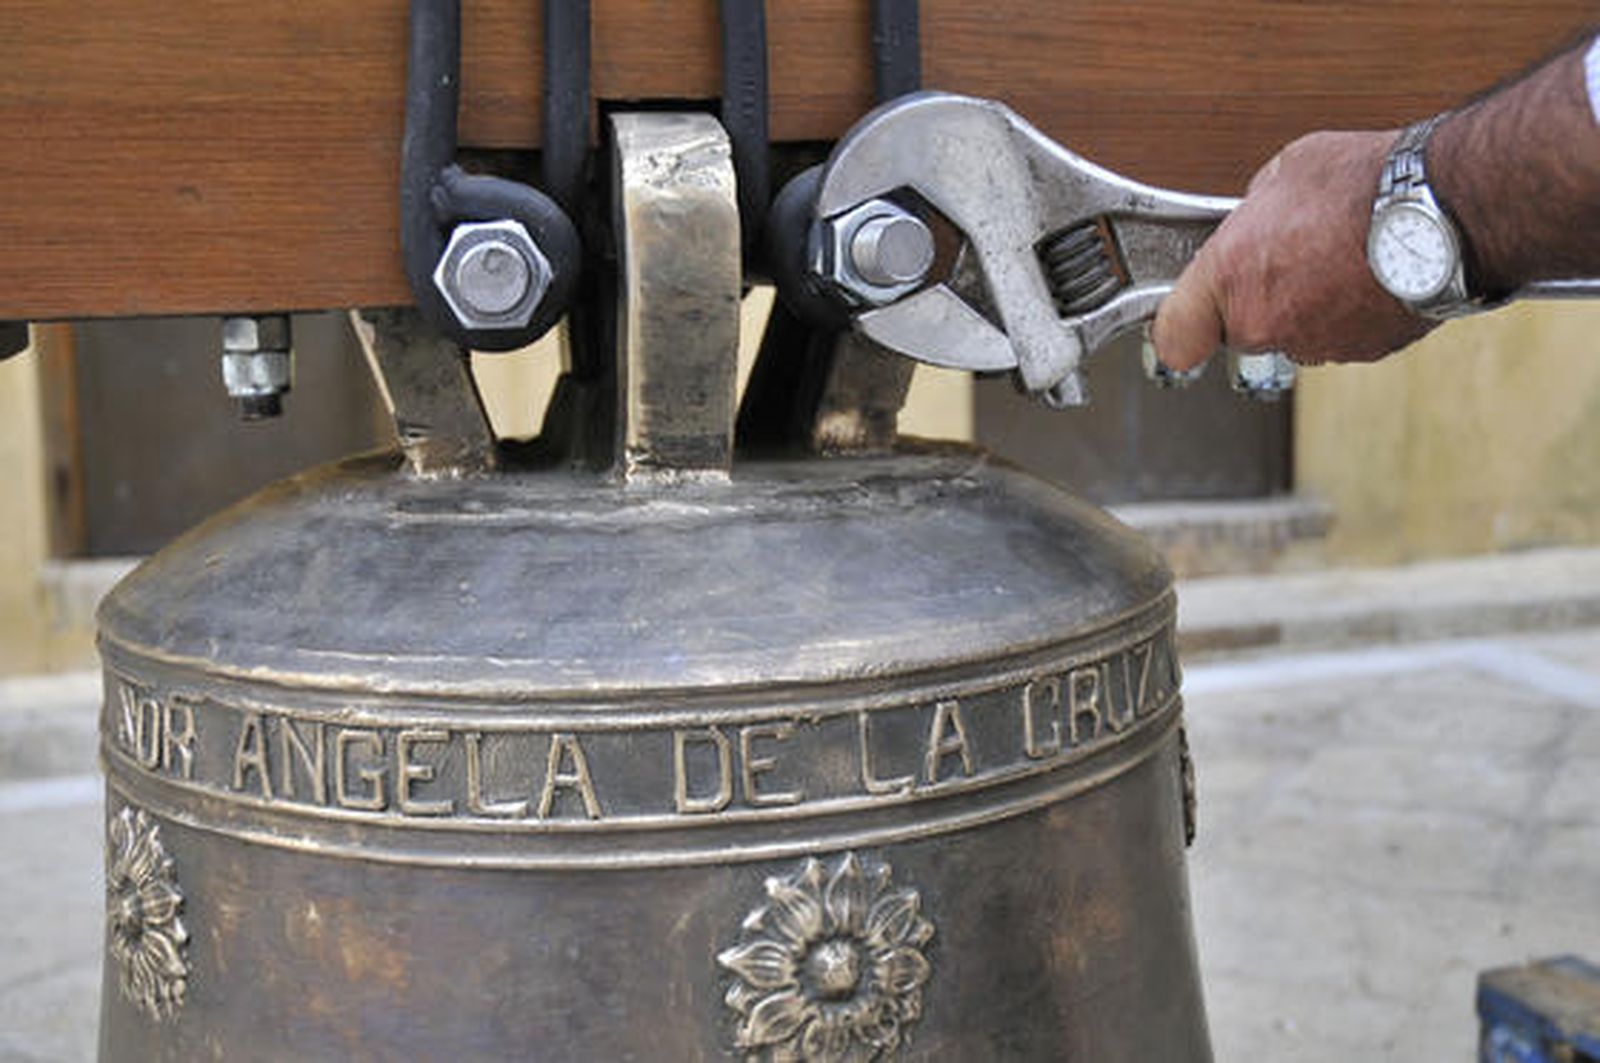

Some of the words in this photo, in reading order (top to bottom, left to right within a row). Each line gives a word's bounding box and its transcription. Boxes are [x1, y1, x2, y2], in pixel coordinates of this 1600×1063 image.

[232, 712, 602, 820] ANGELA
[674, 721, 802, 815] DE
[857, 699, 974, 798] LA
